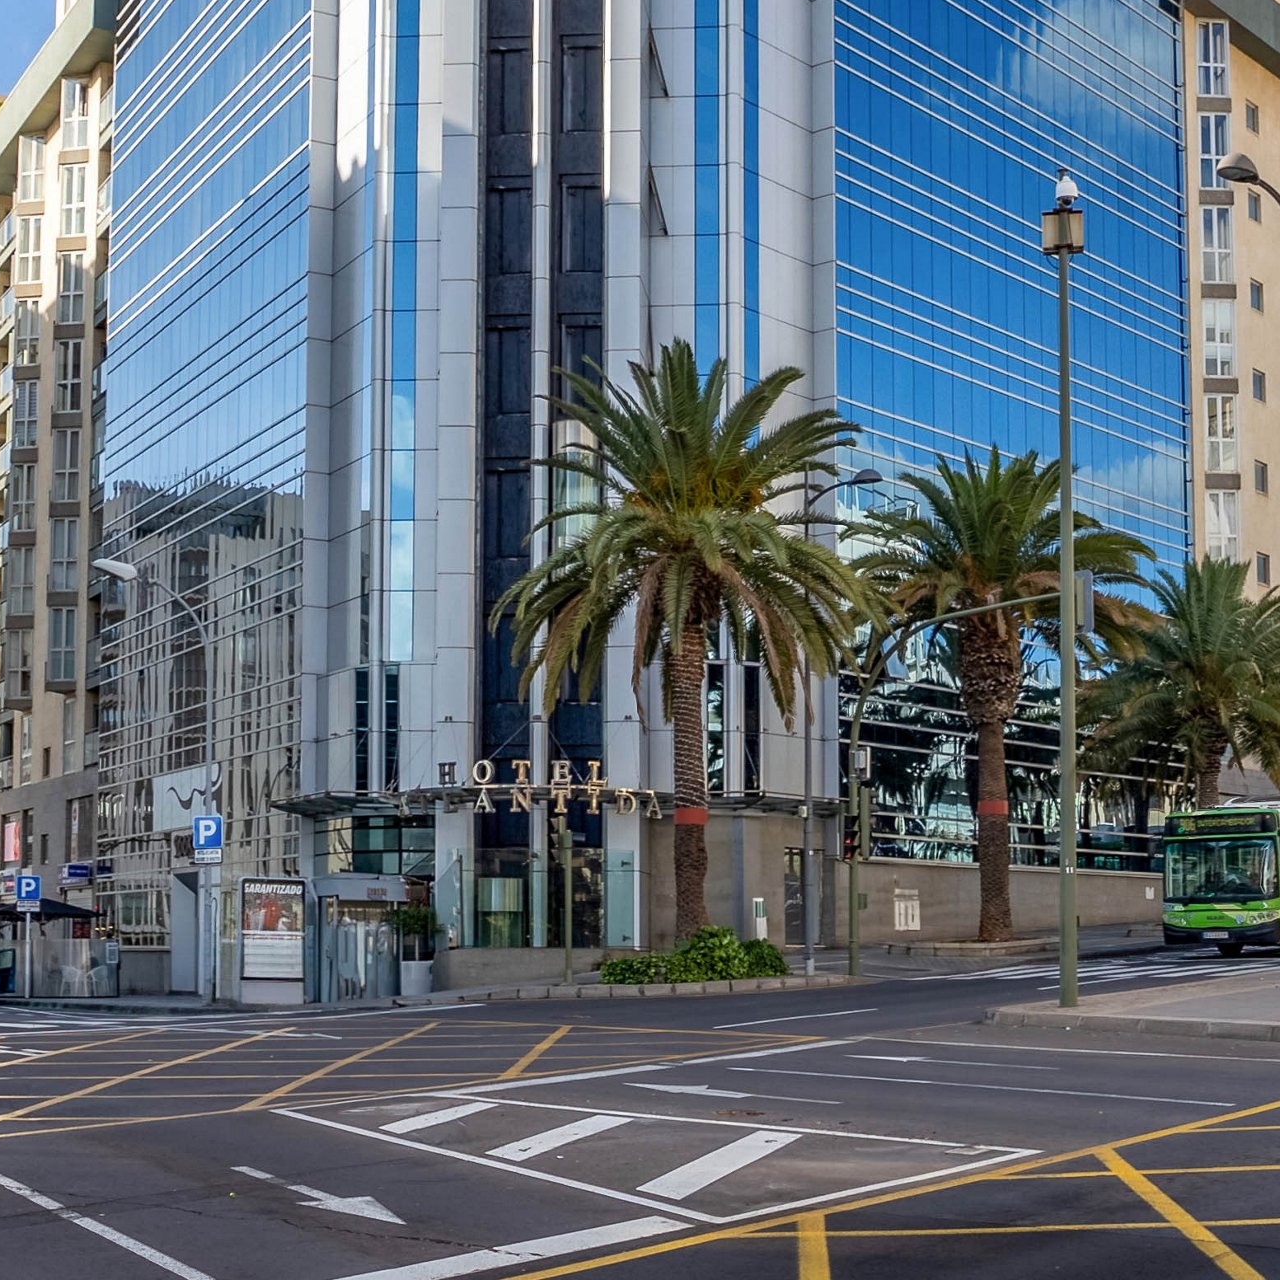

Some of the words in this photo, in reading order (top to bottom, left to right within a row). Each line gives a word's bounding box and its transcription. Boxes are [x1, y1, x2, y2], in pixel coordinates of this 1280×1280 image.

[438, 759, 609, 787] HOTEL
[398, 786, 663, 820] ATLANTIDA
[198, 819, 217, 845] P
[21, 878, 36, 898] P
